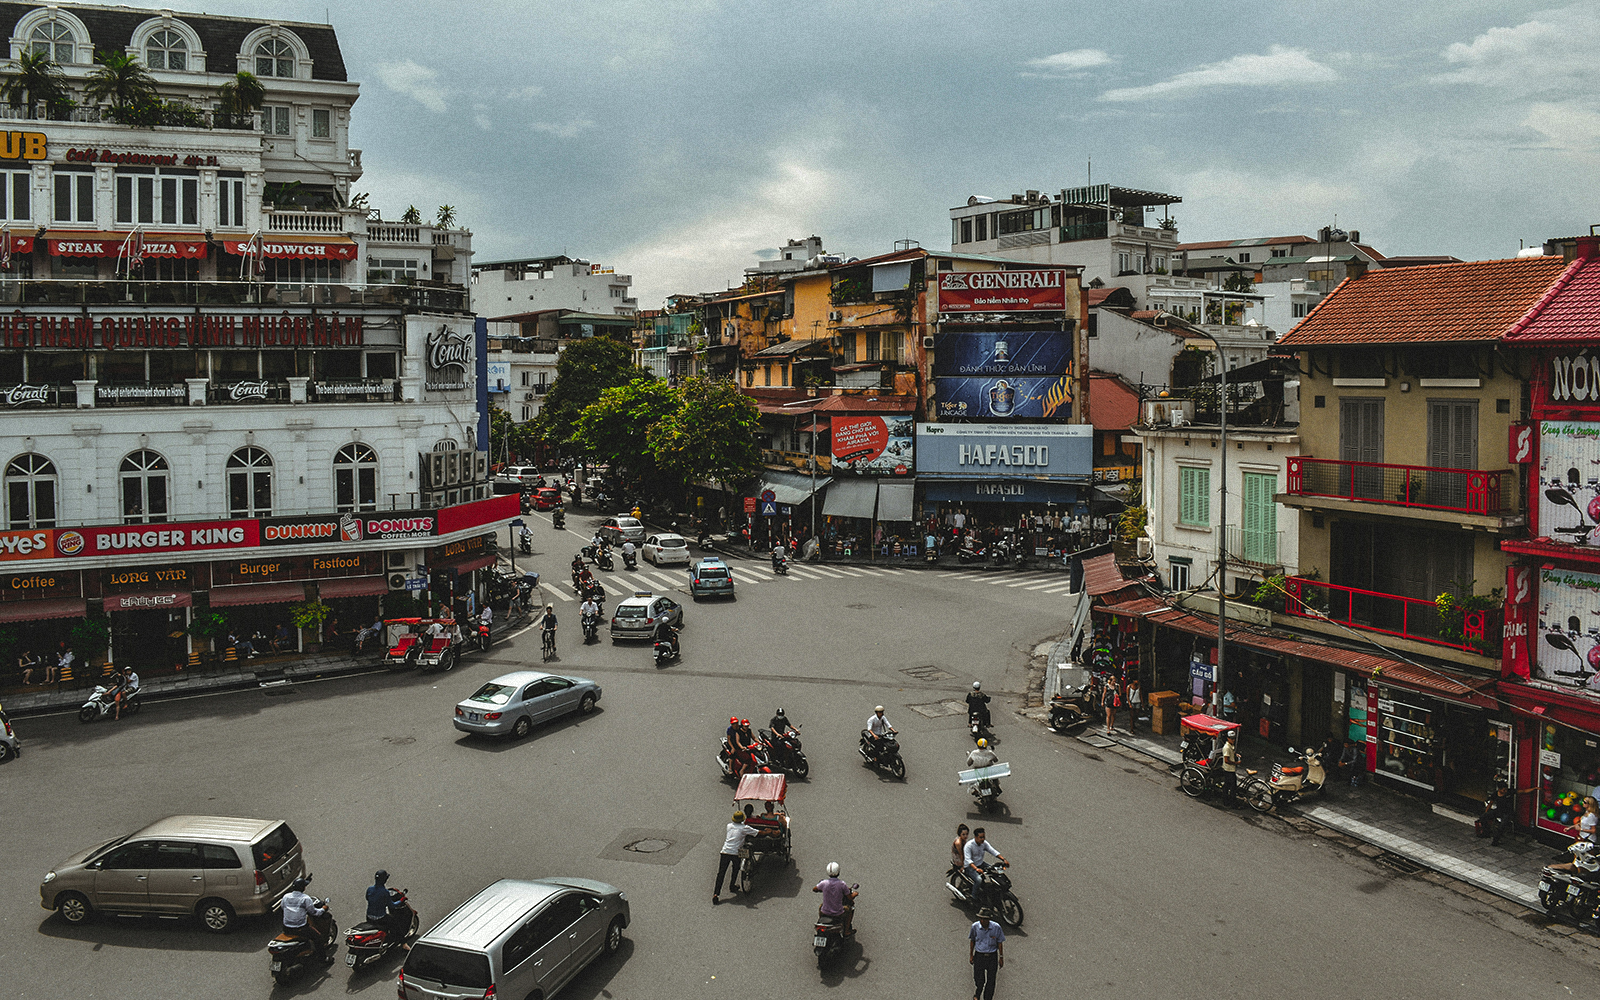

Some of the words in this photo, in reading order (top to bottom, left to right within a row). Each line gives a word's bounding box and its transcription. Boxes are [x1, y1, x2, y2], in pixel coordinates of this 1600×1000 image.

[66, 148, 98, 162] Café
[100, 150, 178, 166] Restaurant
[58, 242, 104, 254] STEAK
[141, 244, 178, 254] PIZZA
[969, 272, 1061, 289] GENERALI
[41, 317, 94, 348] NAM
[101, 316, 180, 350] QUANG
[184, 316, 235, 346] VINH
[242, 310, 308, 346] MUÔN
[314, 310, 363, 346] NĂM
[991, 391, 1014, 402] Tiger
[940, 402, 957, 410] Tiger
[958, 444, 1048, 466] HAFASCO
[976, 484, 1024, 496] HAFASCO
[265, 522, 337, 540] DUNKIN'
[368, 518, 432, 534] DONUTS
[61, 540, 82, 550] KING
[96, 530, 186, 550] BURGER
[191, 527, 244, 546] KING
[240, 563, 280, 576] Burger
[314, 556, 360, 570] Fastfood
[12, 576, 55, 589] Coffee
[110, 572, 148, 584] LONG
[1510, 642, 1516, 660] 1
